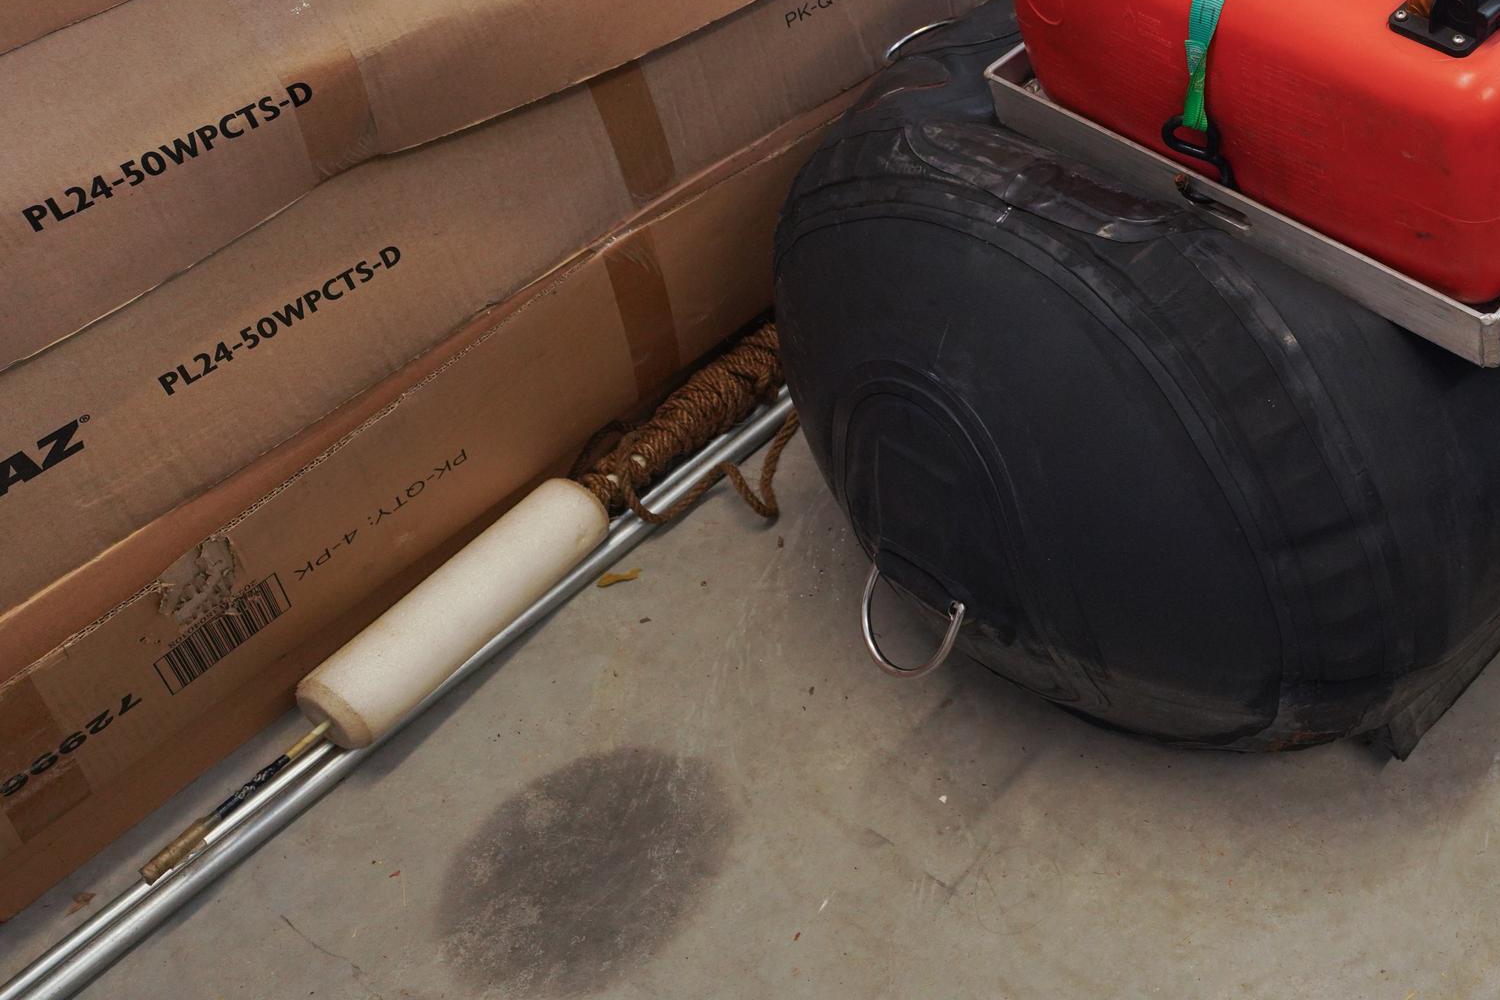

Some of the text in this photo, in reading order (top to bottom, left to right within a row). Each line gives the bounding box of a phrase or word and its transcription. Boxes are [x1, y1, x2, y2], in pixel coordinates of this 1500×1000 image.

[22, 80, 314, 233] PL24-50WPCTS-D
[157, 244, 402, 396] PL24-50WPCTS-D
[294, 448, 468, 582] PK-QTY: 4-PK
